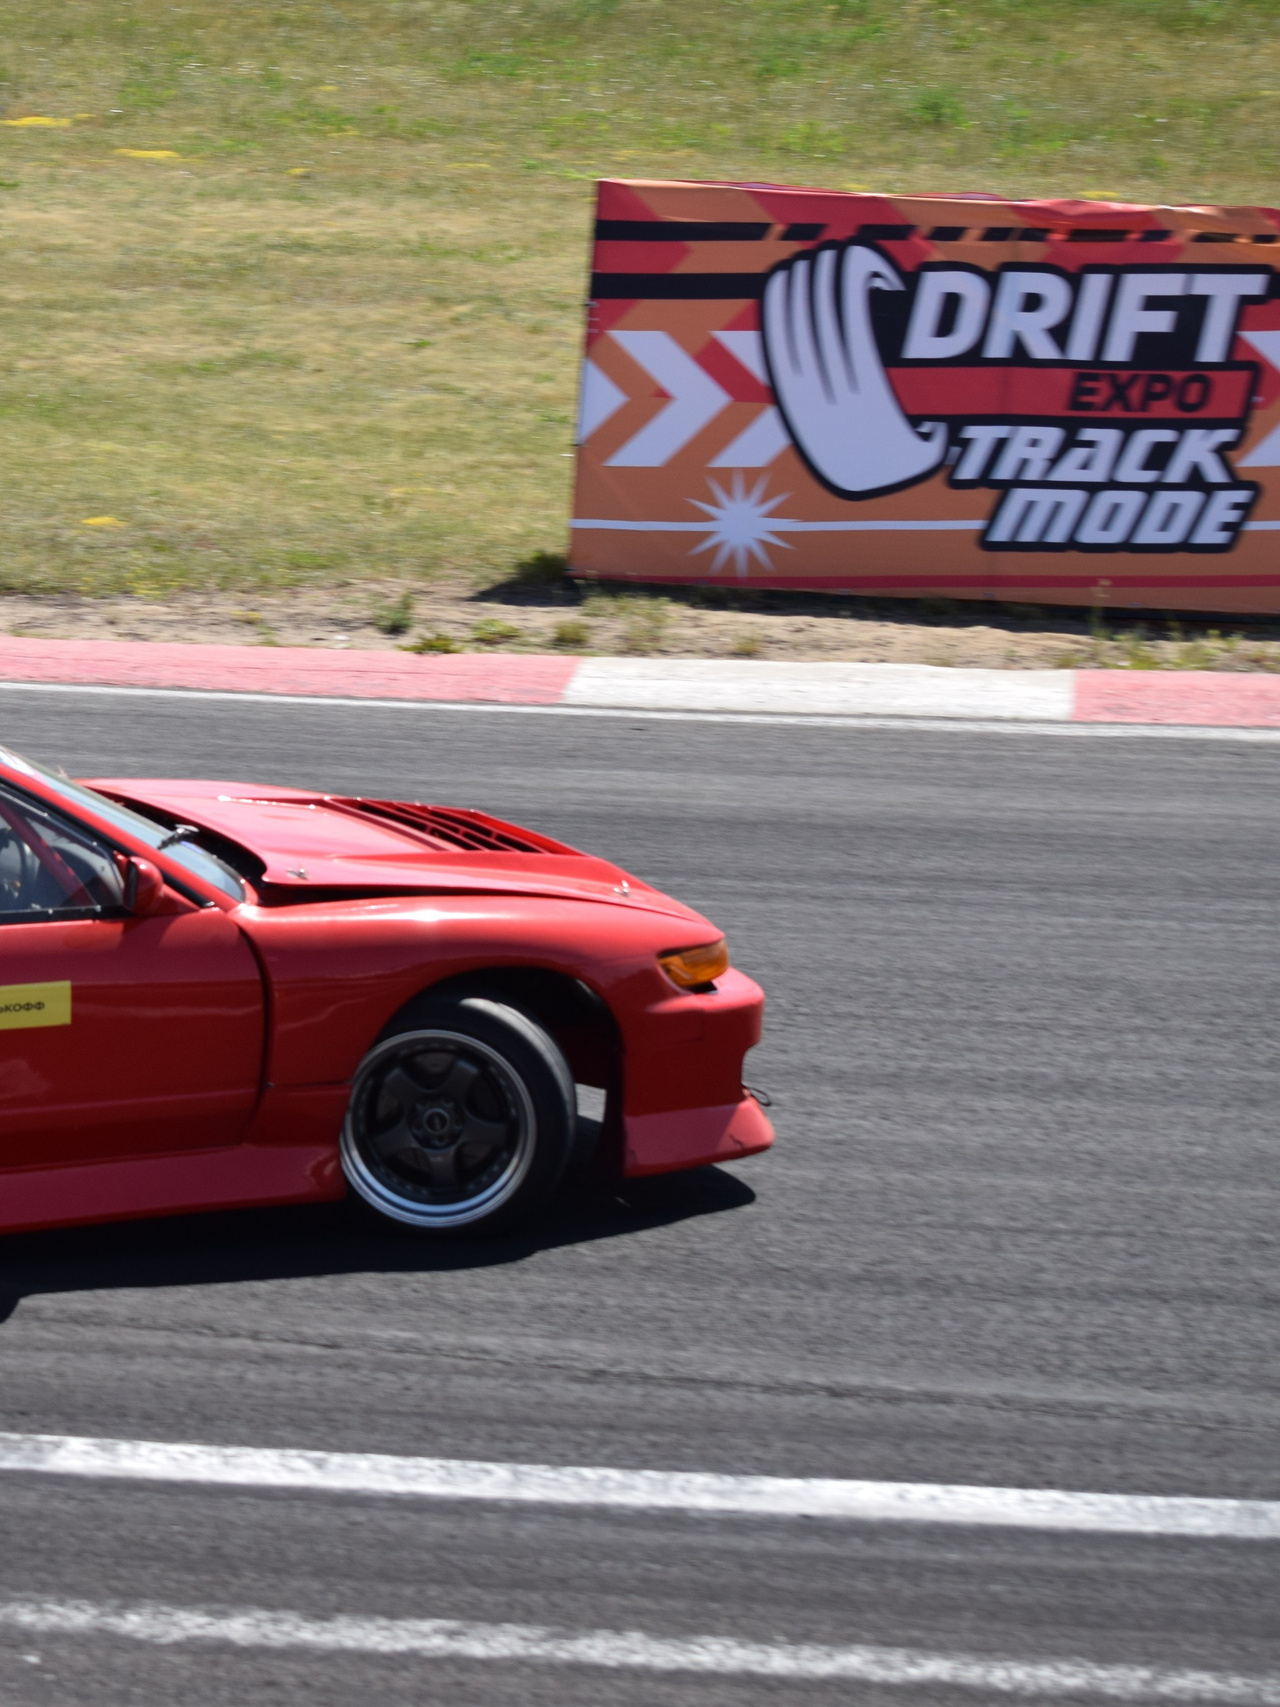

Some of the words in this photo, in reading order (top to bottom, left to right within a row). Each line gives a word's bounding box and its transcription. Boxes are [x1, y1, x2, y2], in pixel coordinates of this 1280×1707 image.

[900, 270, 1270, 362] DRIFT
[1066, 372, 1212, 412] EXPO
[951, 425, 1242, 483] TRACK
[984, 487, 1255, 544] MODE
